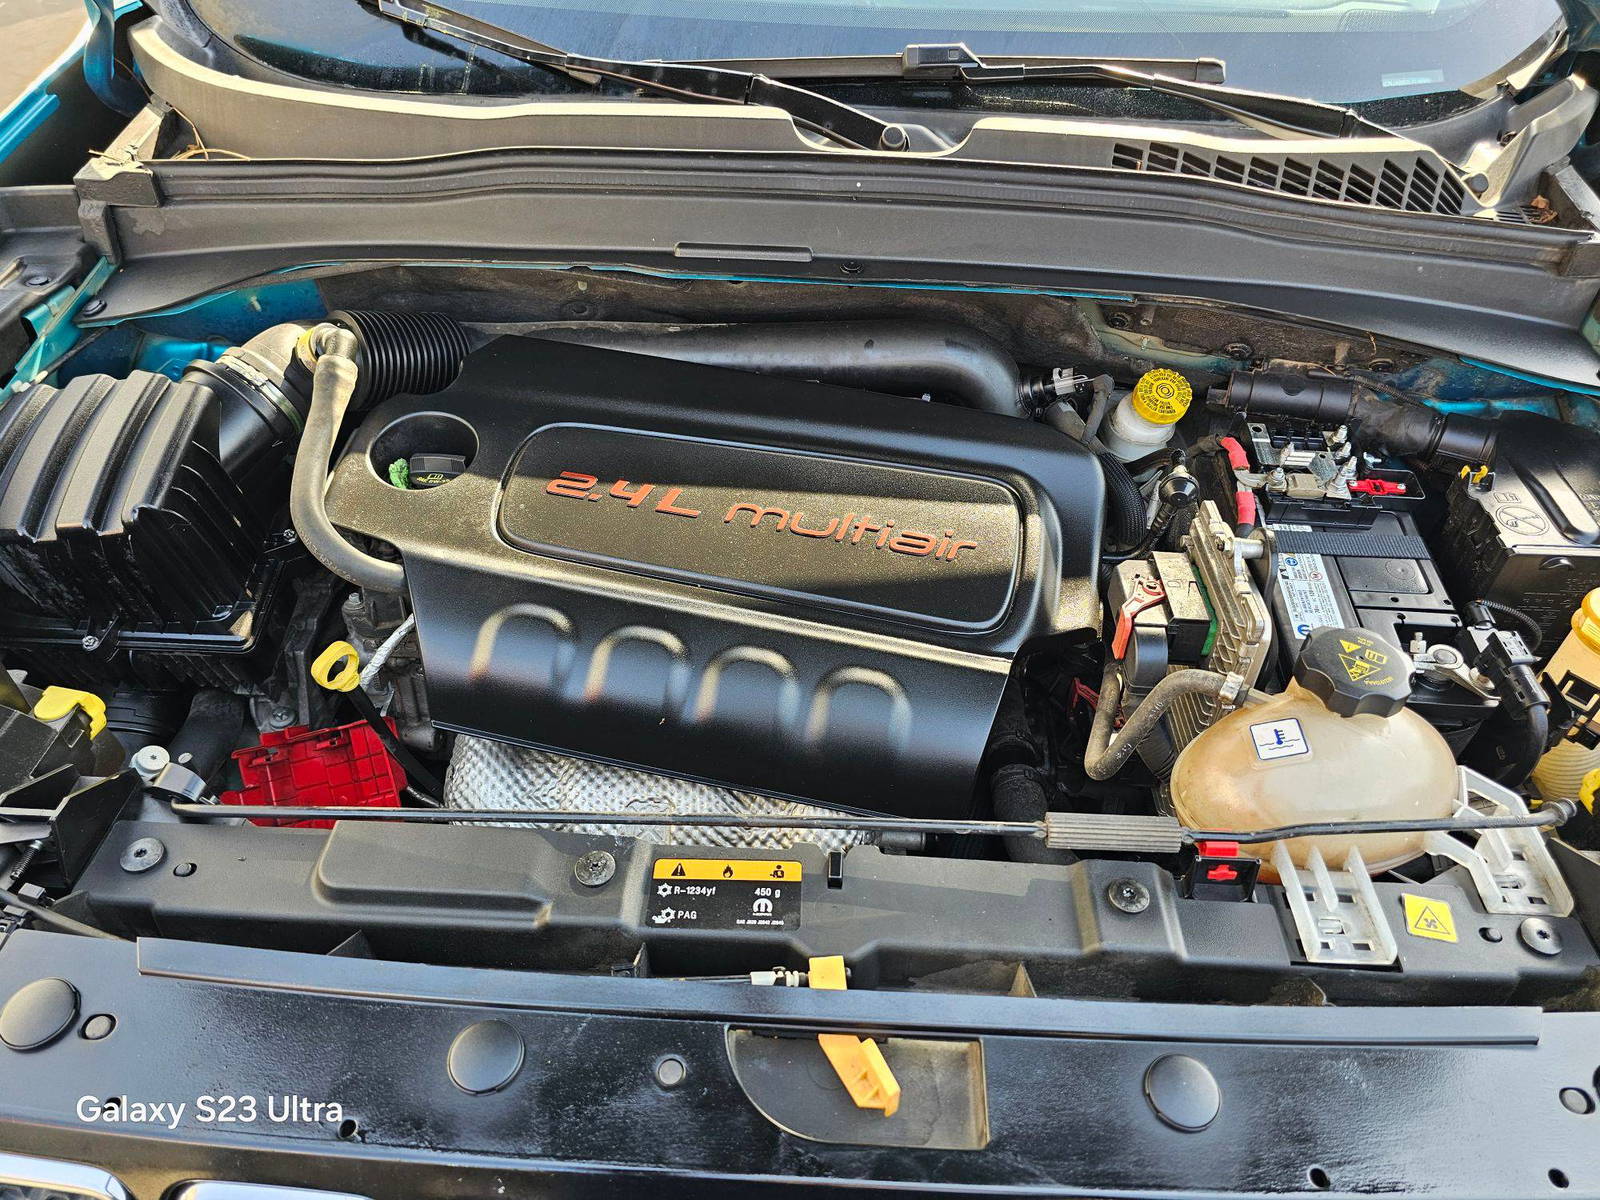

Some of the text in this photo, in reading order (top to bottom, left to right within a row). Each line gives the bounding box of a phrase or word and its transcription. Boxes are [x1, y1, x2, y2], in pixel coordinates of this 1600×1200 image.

[546, 471, 978, 562] 2.4L multiair
[674, 886, 716, 897] R-1234yf
[754, 887, 772, 897] 450
[677, 911, 697, 919] PAG
